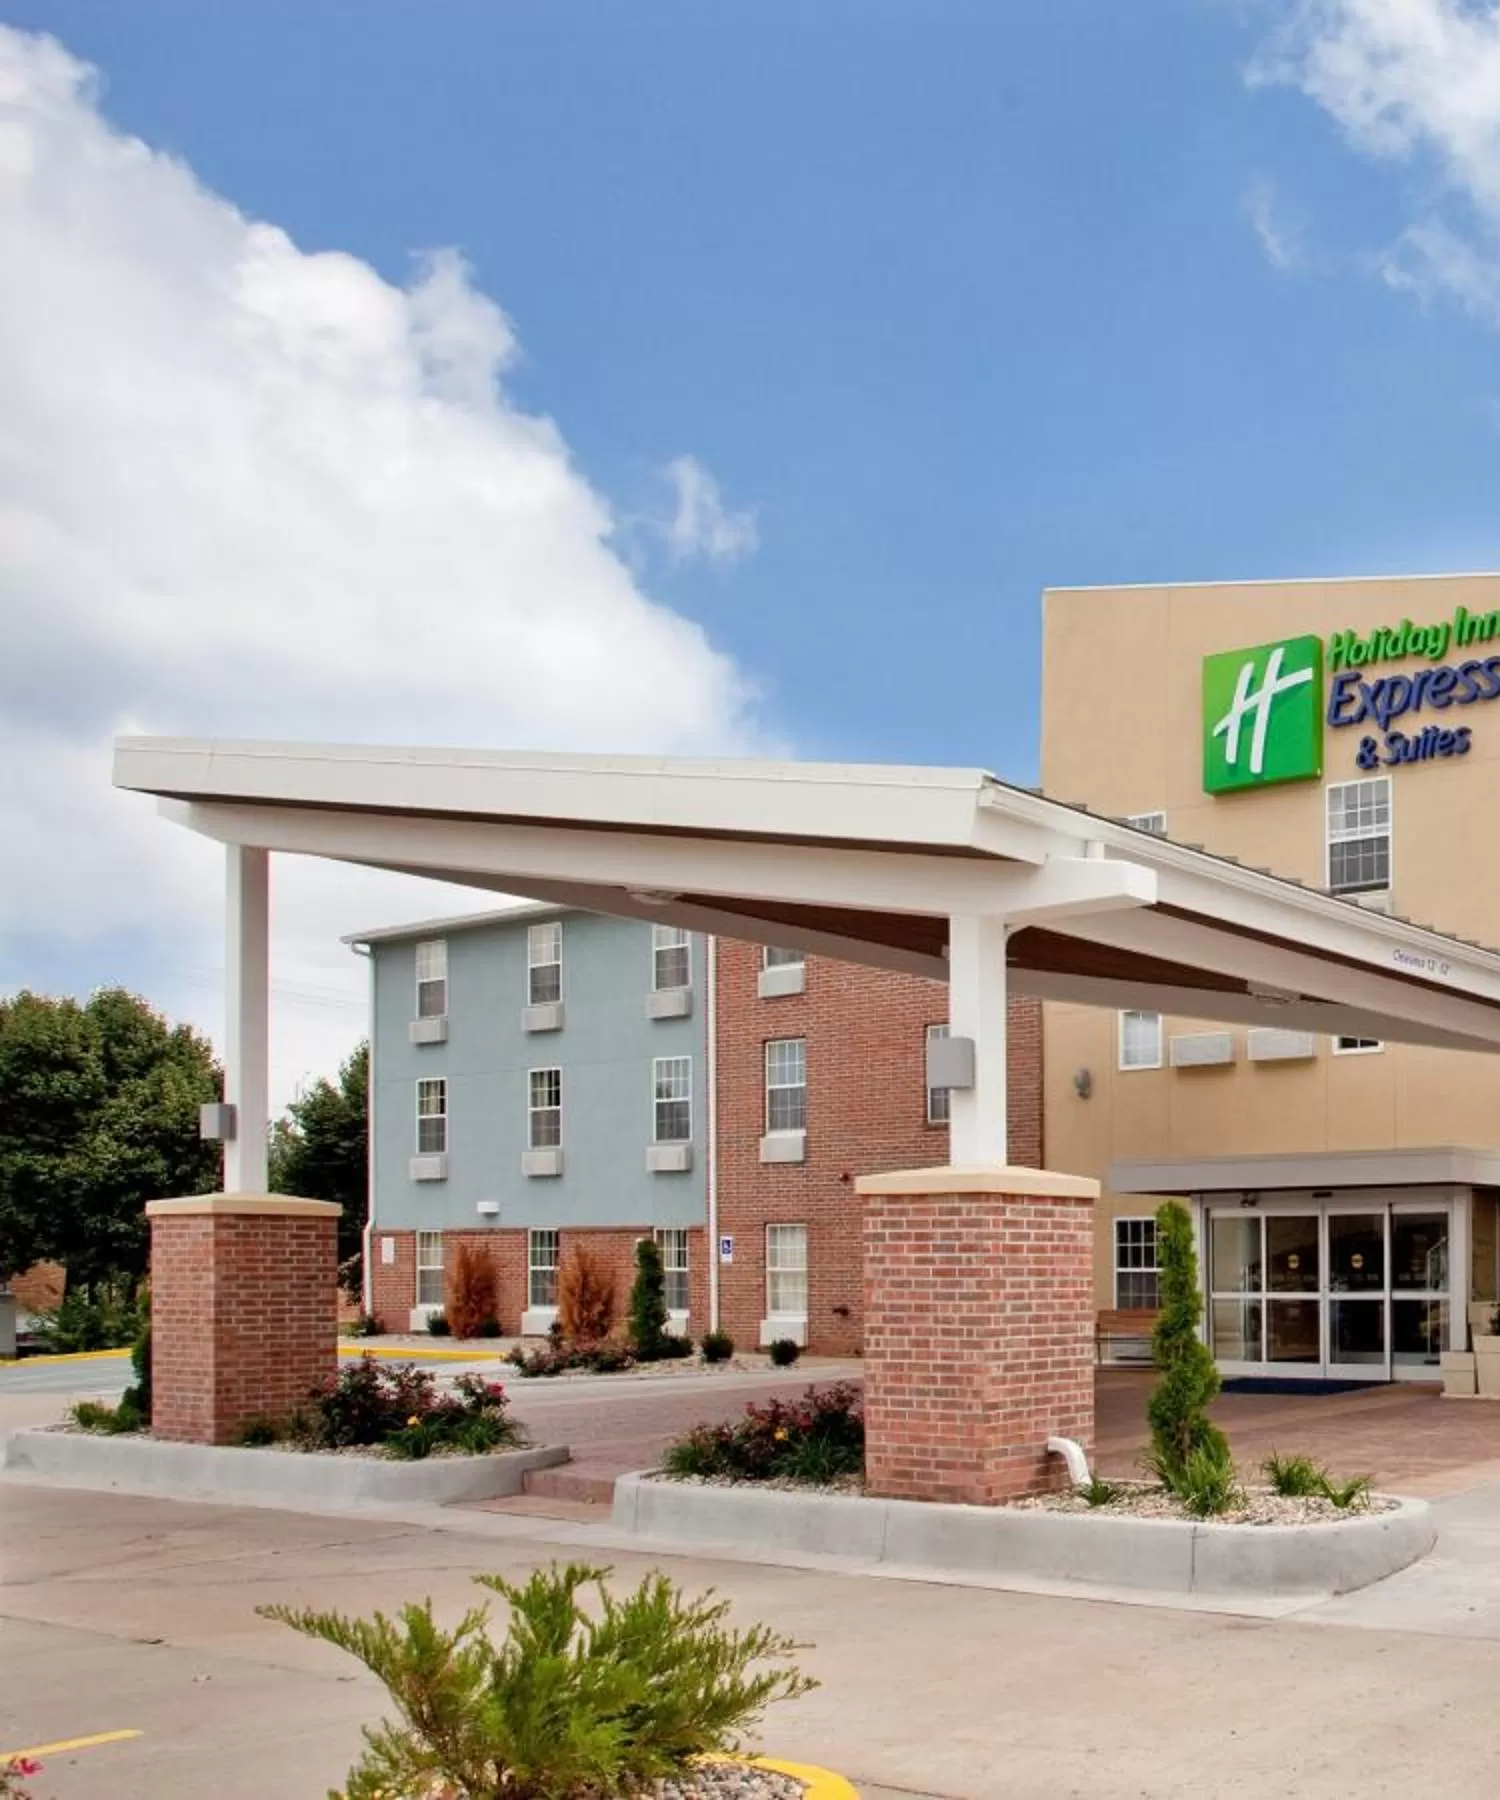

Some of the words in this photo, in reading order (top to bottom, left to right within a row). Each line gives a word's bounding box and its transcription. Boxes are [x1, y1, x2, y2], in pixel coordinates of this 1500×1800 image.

[1328, 618, 1450, 671] Holiday
[1356, 736, 1380, 770] &
[1383, 725, 1472, 766] Suites
